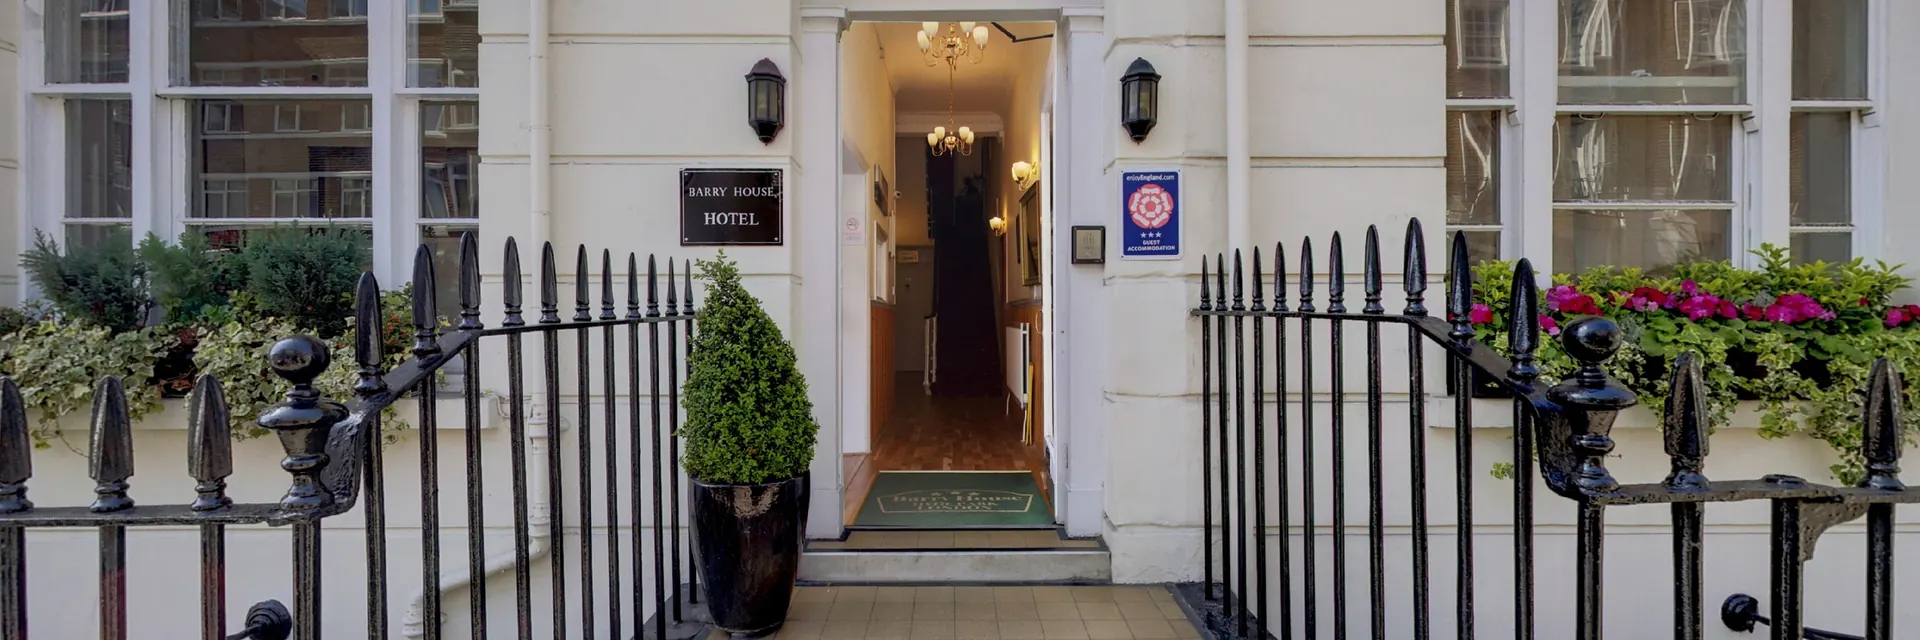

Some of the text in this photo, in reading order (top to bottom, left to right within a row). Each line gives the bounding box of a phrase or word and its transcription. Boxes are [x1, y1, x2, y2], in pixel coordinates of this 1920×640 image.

[1126, 174, 1175, 182] enjoyEngland.com
[688, 187, 774, 197] BARRY HOUSE
[703, 212, 760, 226] HOTEL
